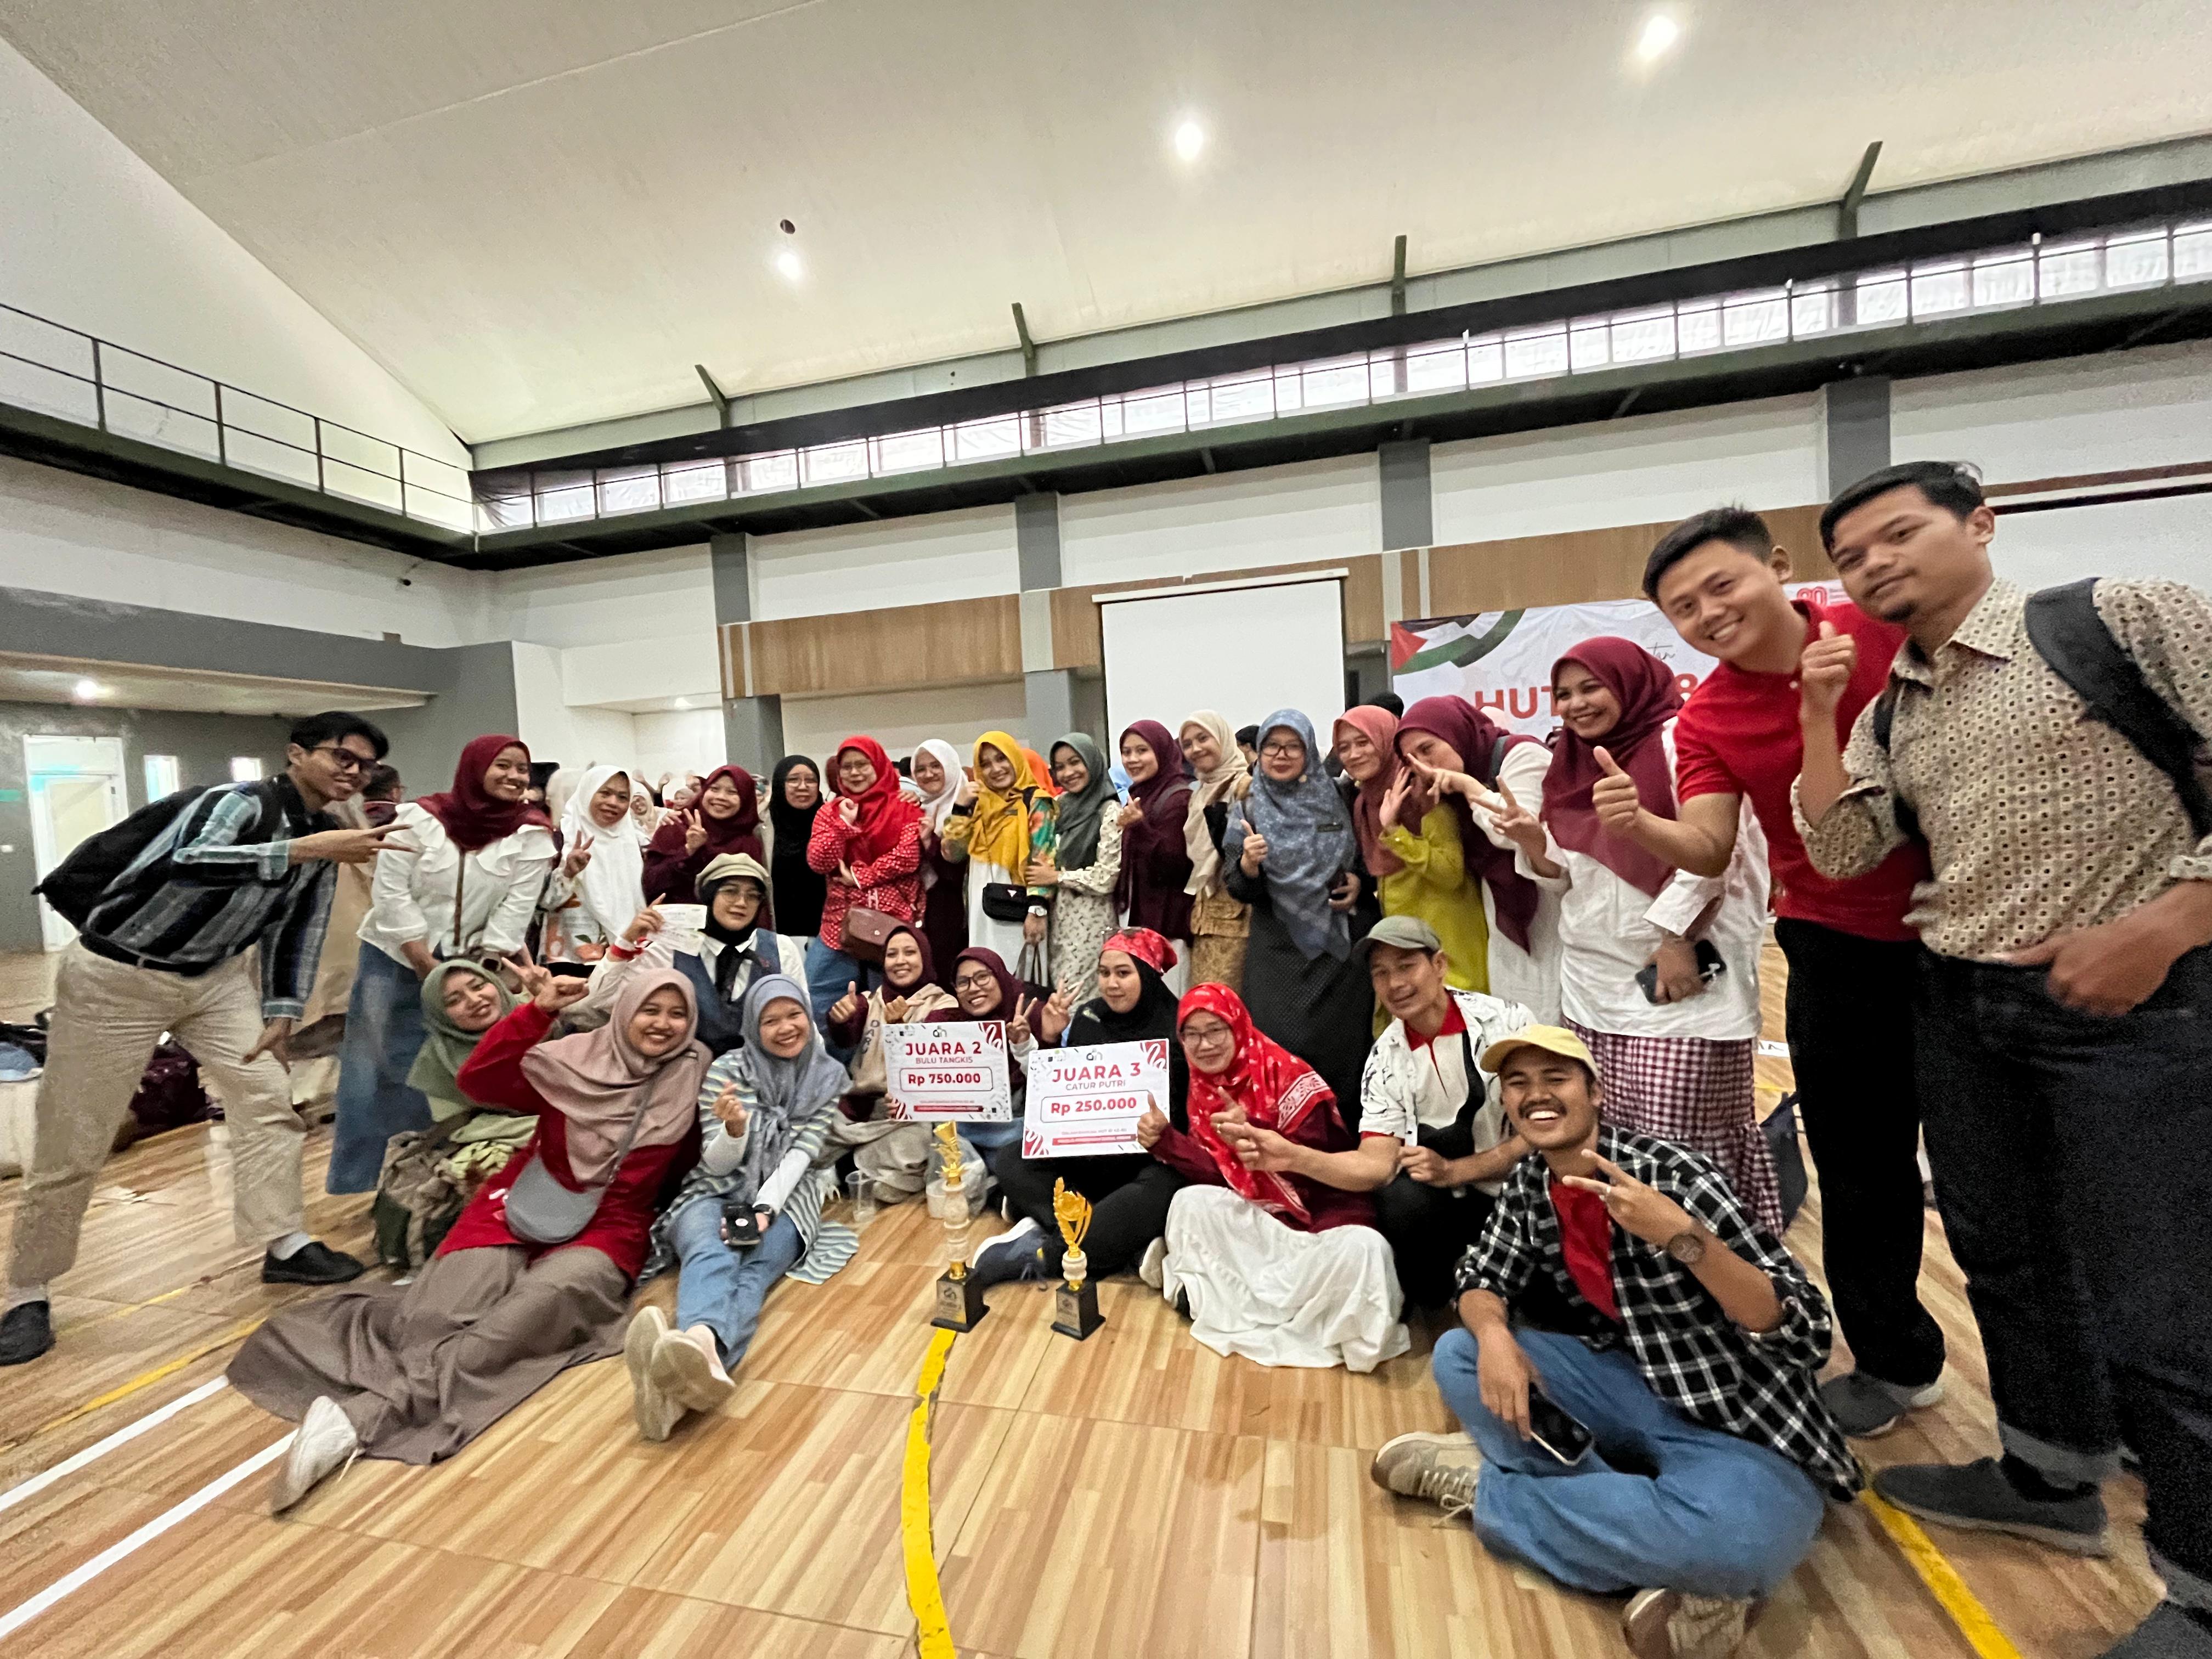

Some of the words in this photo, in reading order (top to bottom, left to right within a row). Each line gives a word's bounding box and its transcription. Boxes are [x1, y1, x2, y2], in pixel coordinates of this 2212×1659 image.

[905, 1042, 965, 1056] JUARA
[972, 1041, 982, 1054] 2
[908, 1074, 925, 1086] Rp
[928, 1073, 980, 1084] 750.000
[1052, 1064, 1122, 1083] JUARA
[1130, 1062, 1141, 1077] 3
[1065, 1082, 1096, 1091] CATUR
[1099, 1080, 1126, 1088] PUTRI
[1051, 1103, 1070, 1116] Rp
[1075, 1097, 1137, 1112] 250.000
